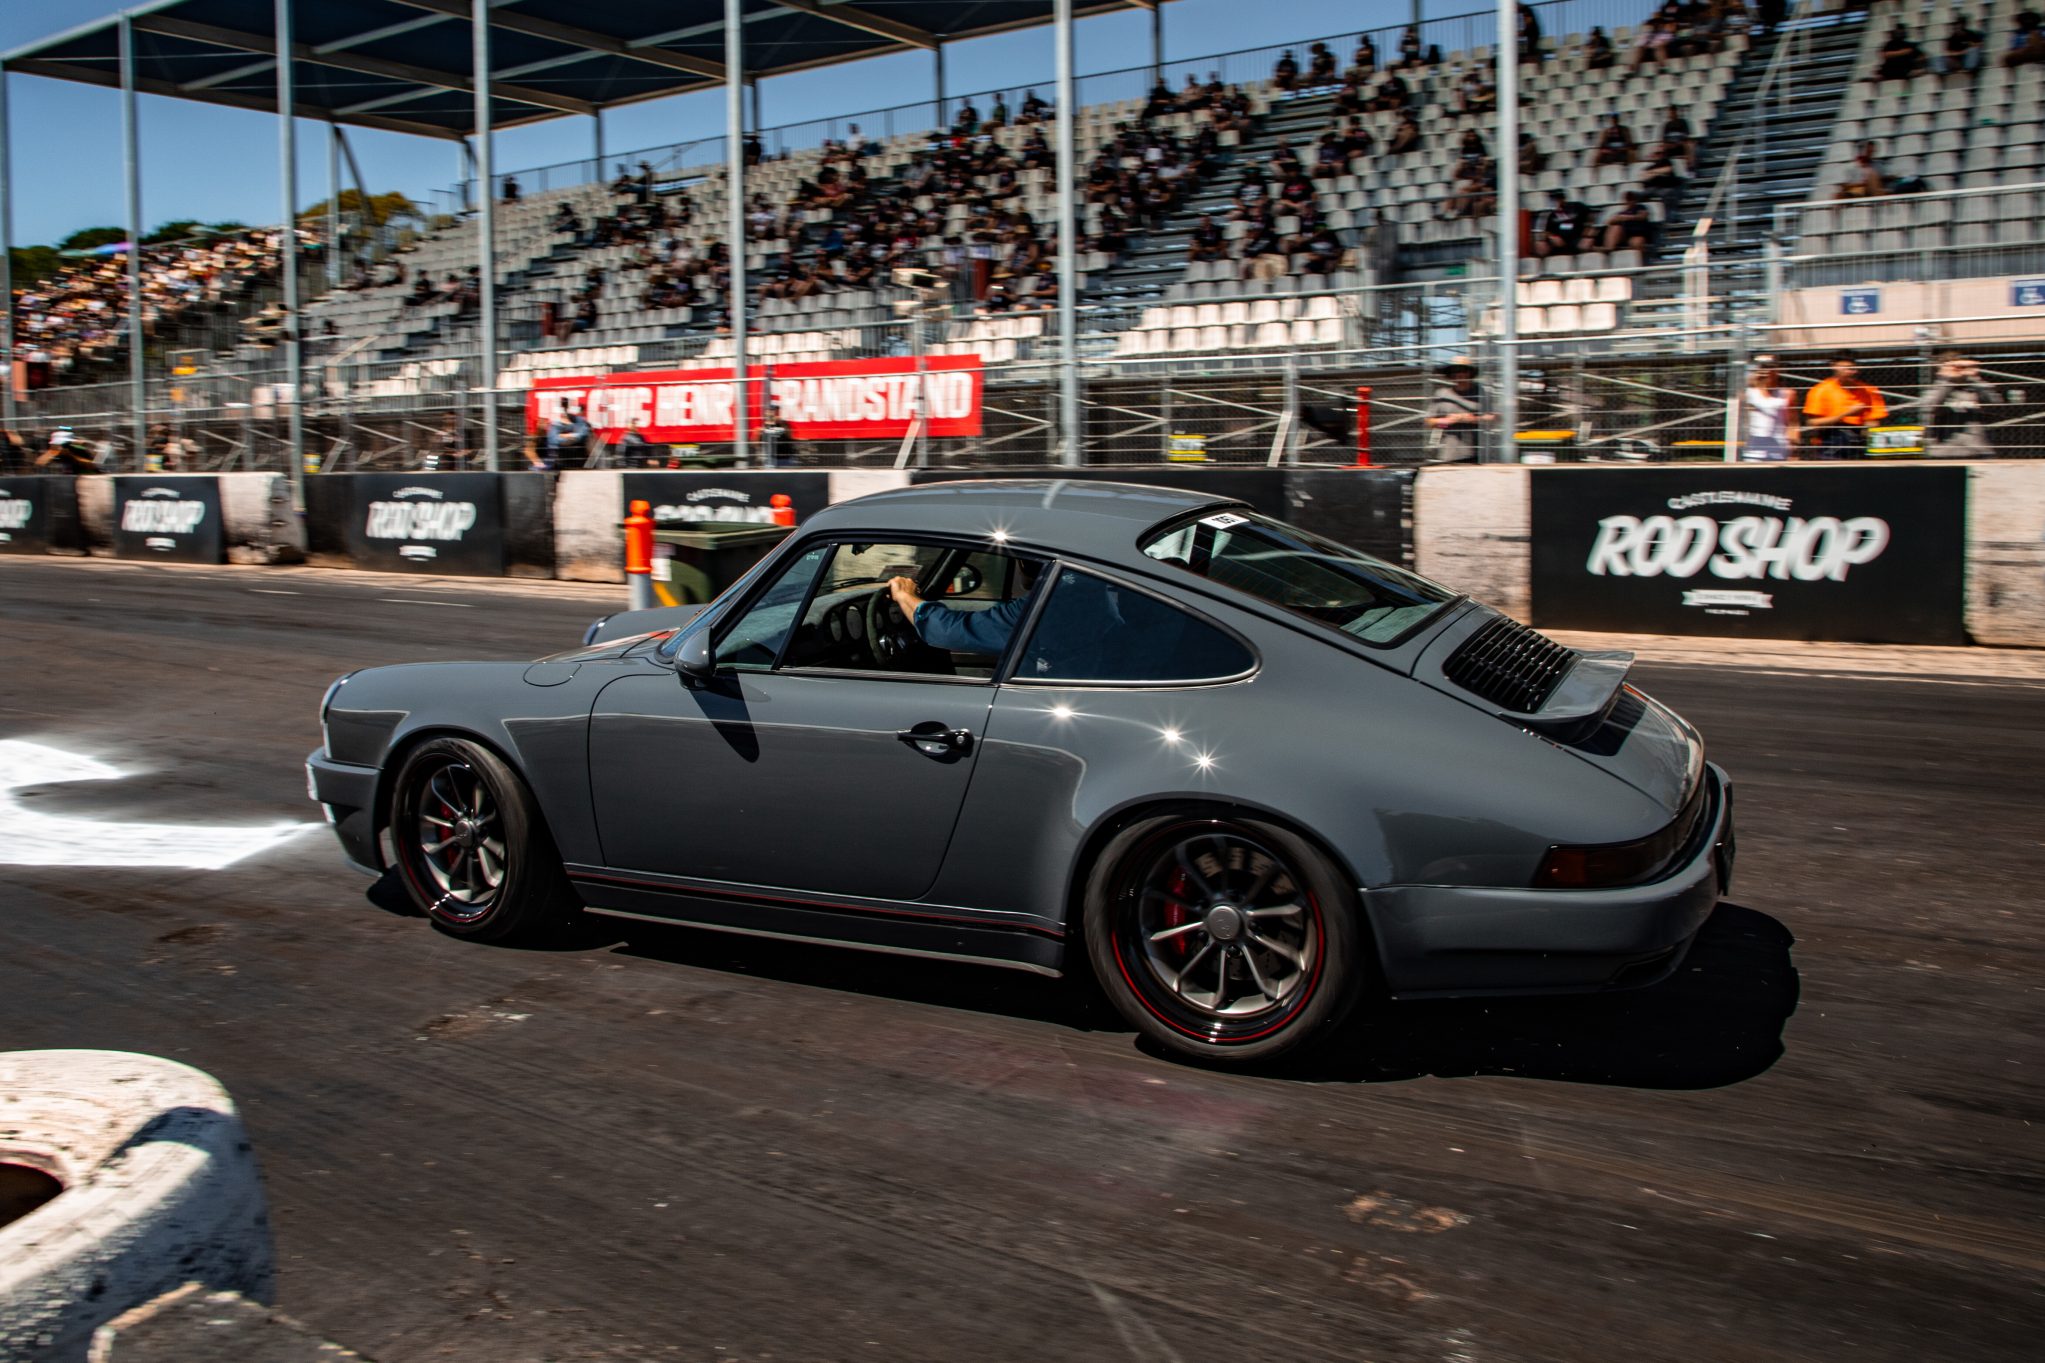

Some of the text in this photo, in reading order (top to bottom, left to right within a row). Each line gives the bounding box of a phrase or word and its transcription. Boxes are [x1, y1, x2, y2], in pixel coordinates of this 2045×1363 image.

[655, 383, 738, 427] HENR
[1587, 515, 1890, 582] ROD SHOP
